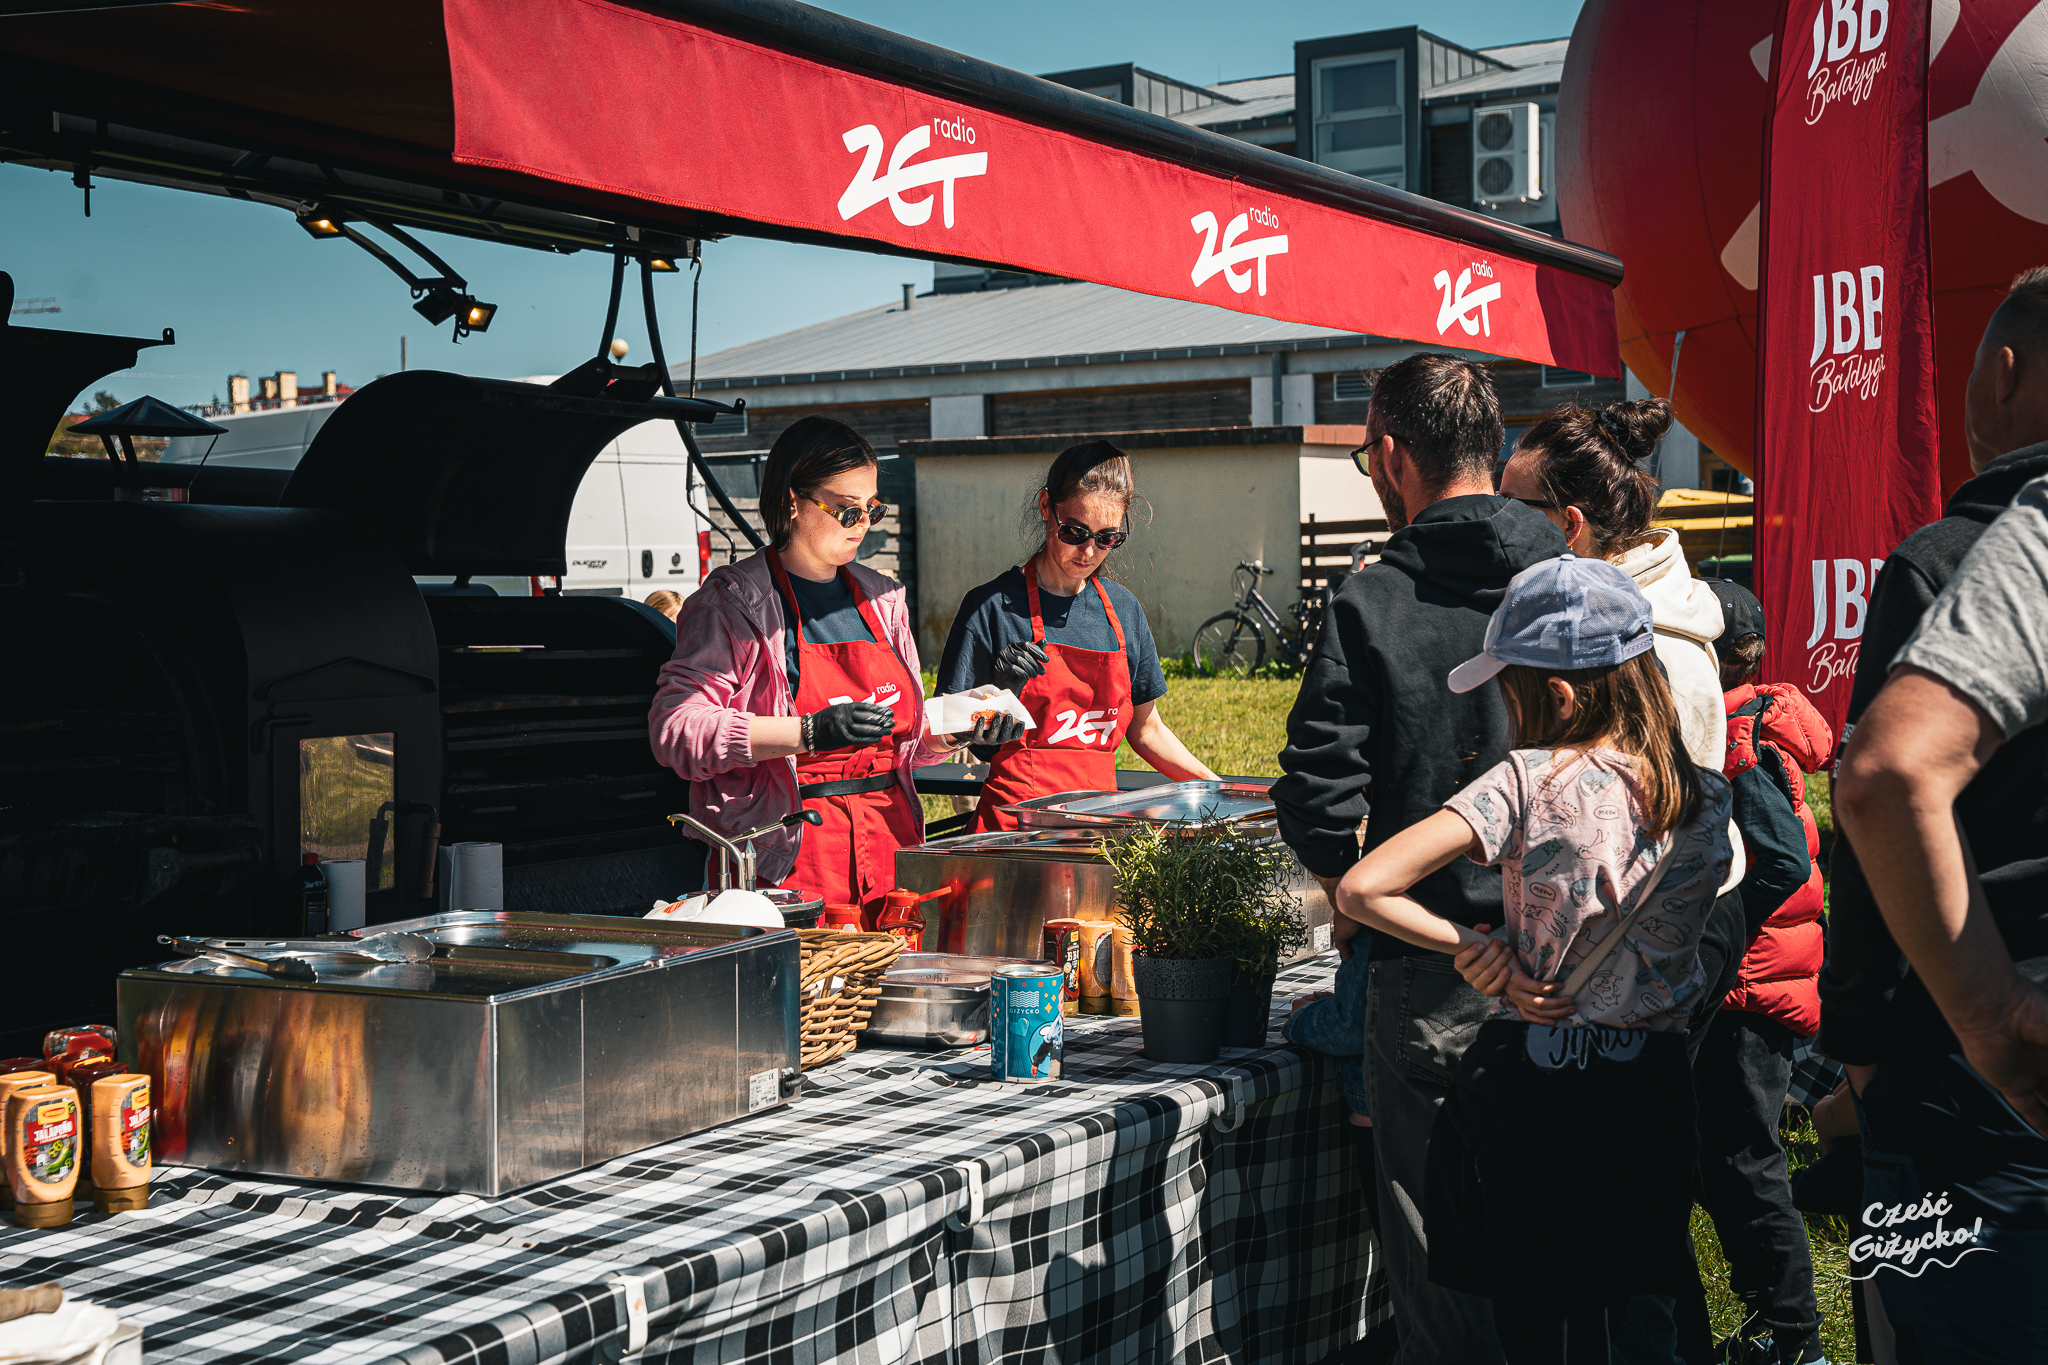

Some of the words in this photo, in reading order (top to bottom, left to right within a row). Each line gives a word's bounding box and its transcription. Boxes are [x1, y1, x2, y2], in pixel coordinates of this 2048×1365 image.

[1804, 51, 1888, 126] Bałdyga
[933, 115, 976, 145] radio
[1249, 205, 1279, 230] radio
[1471, 259, 1494, 279] radio
[1809, 264, 1885, 368] JBB
[876, 682, 897, 694] radio
[33, 1120, 74, 1142] JALAPEÑO
